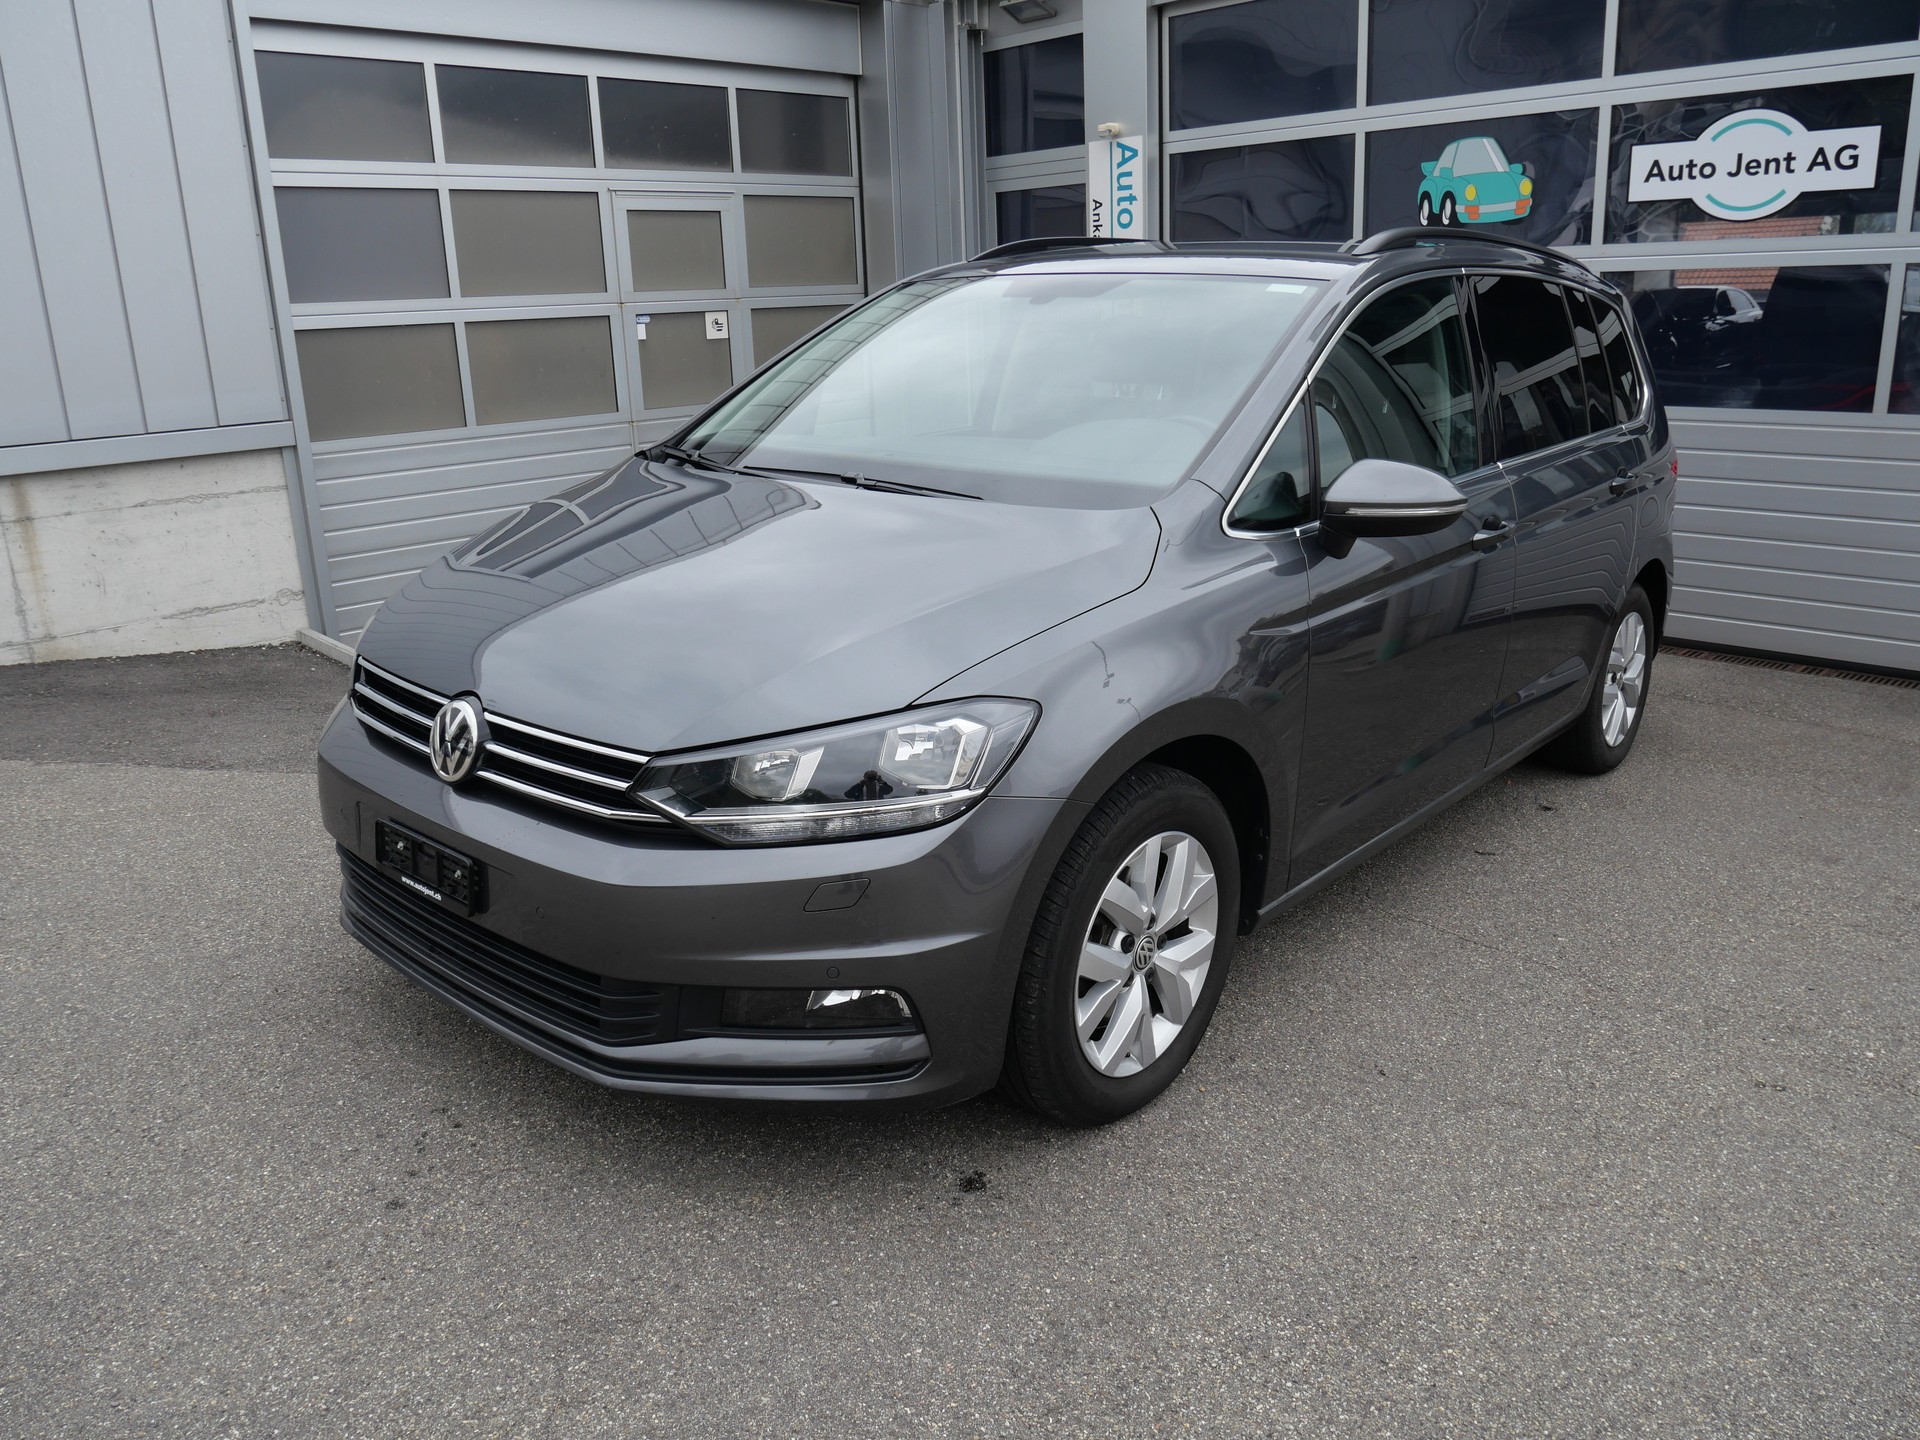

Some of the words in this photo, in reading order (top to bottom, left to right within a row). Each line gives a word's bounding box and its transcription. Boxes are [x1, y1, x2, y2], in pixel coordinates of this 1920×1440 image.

[1116, 141, 1139, 230] Auto
[1643, 159, 1717, 183] Auto
[1726, 151, 1797, 178] Jent
[1805, 144, 1860, 173] AG
